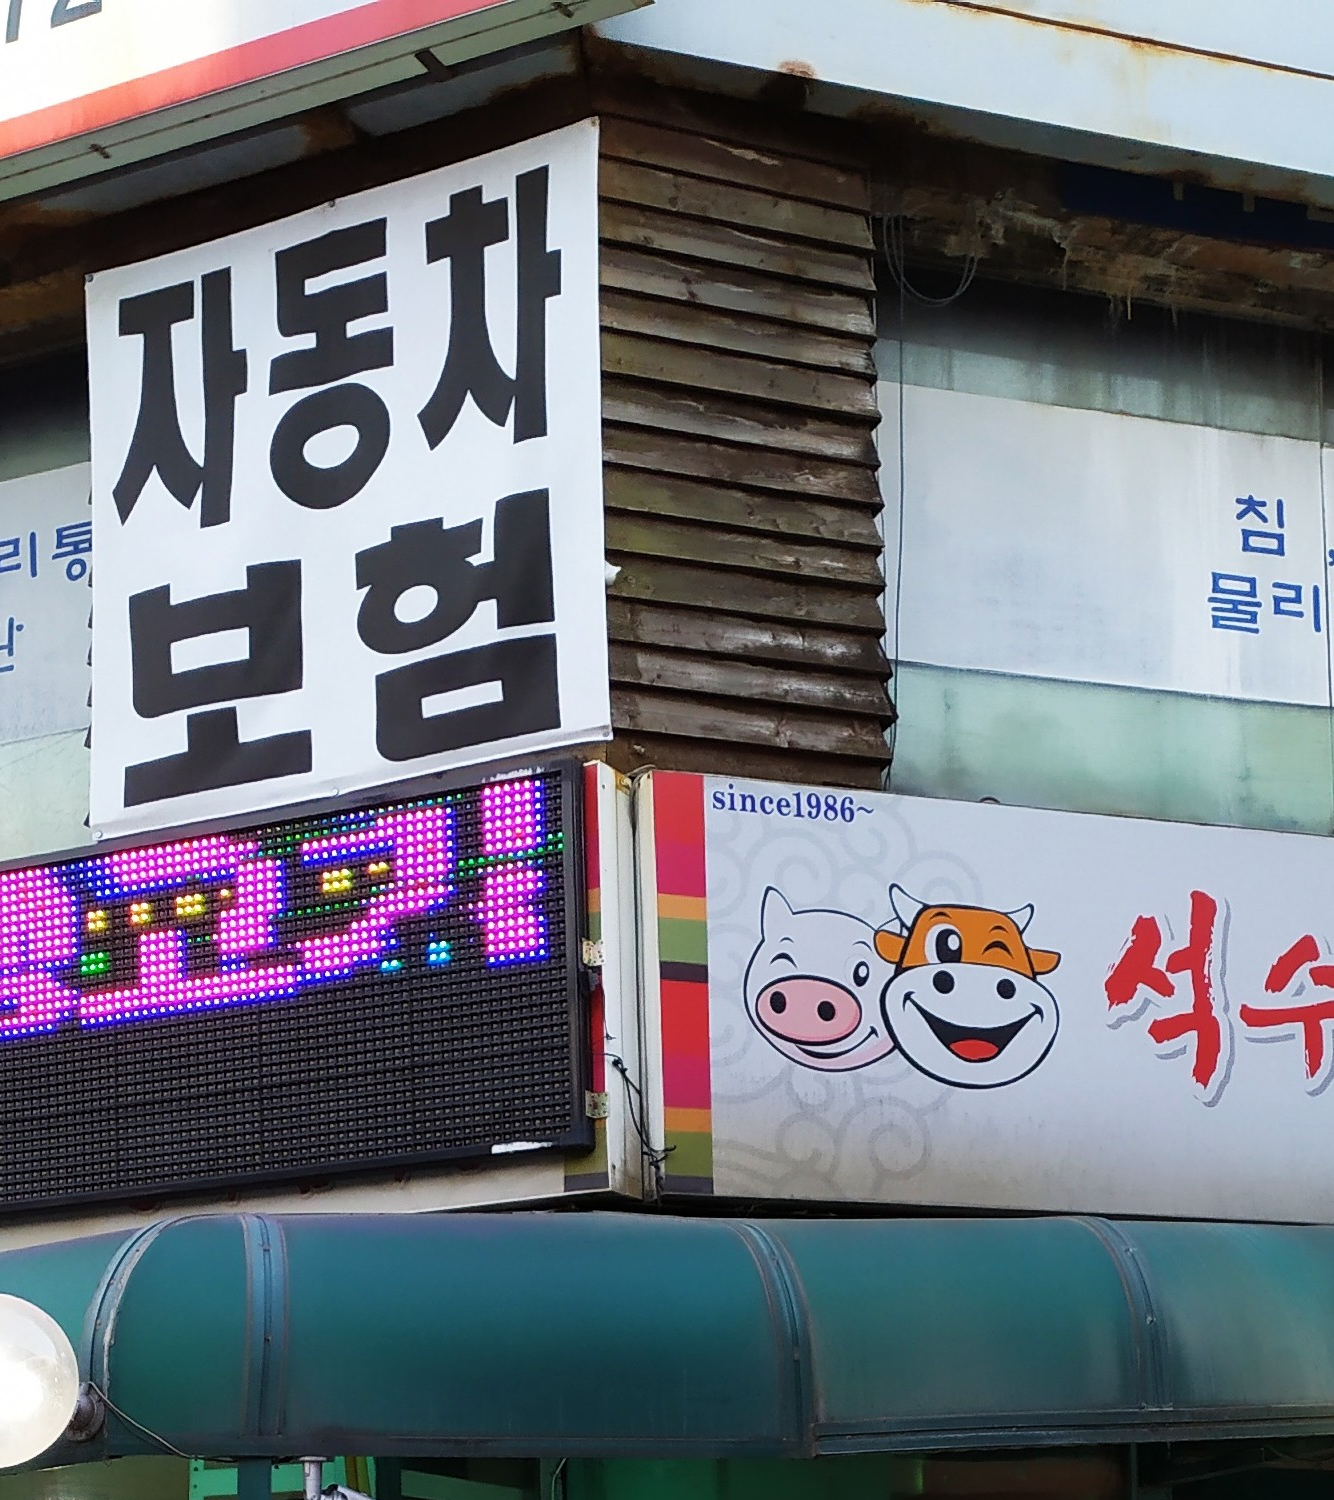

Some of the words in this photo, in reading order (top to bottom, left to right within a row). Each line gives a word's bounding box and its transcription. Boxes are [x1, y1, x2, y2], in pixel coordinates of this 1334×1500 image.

[112, 165, 562, 528] 자동차
[123, 488, 562, 808] 보험
[1235, 495, 1285, 556] 침
